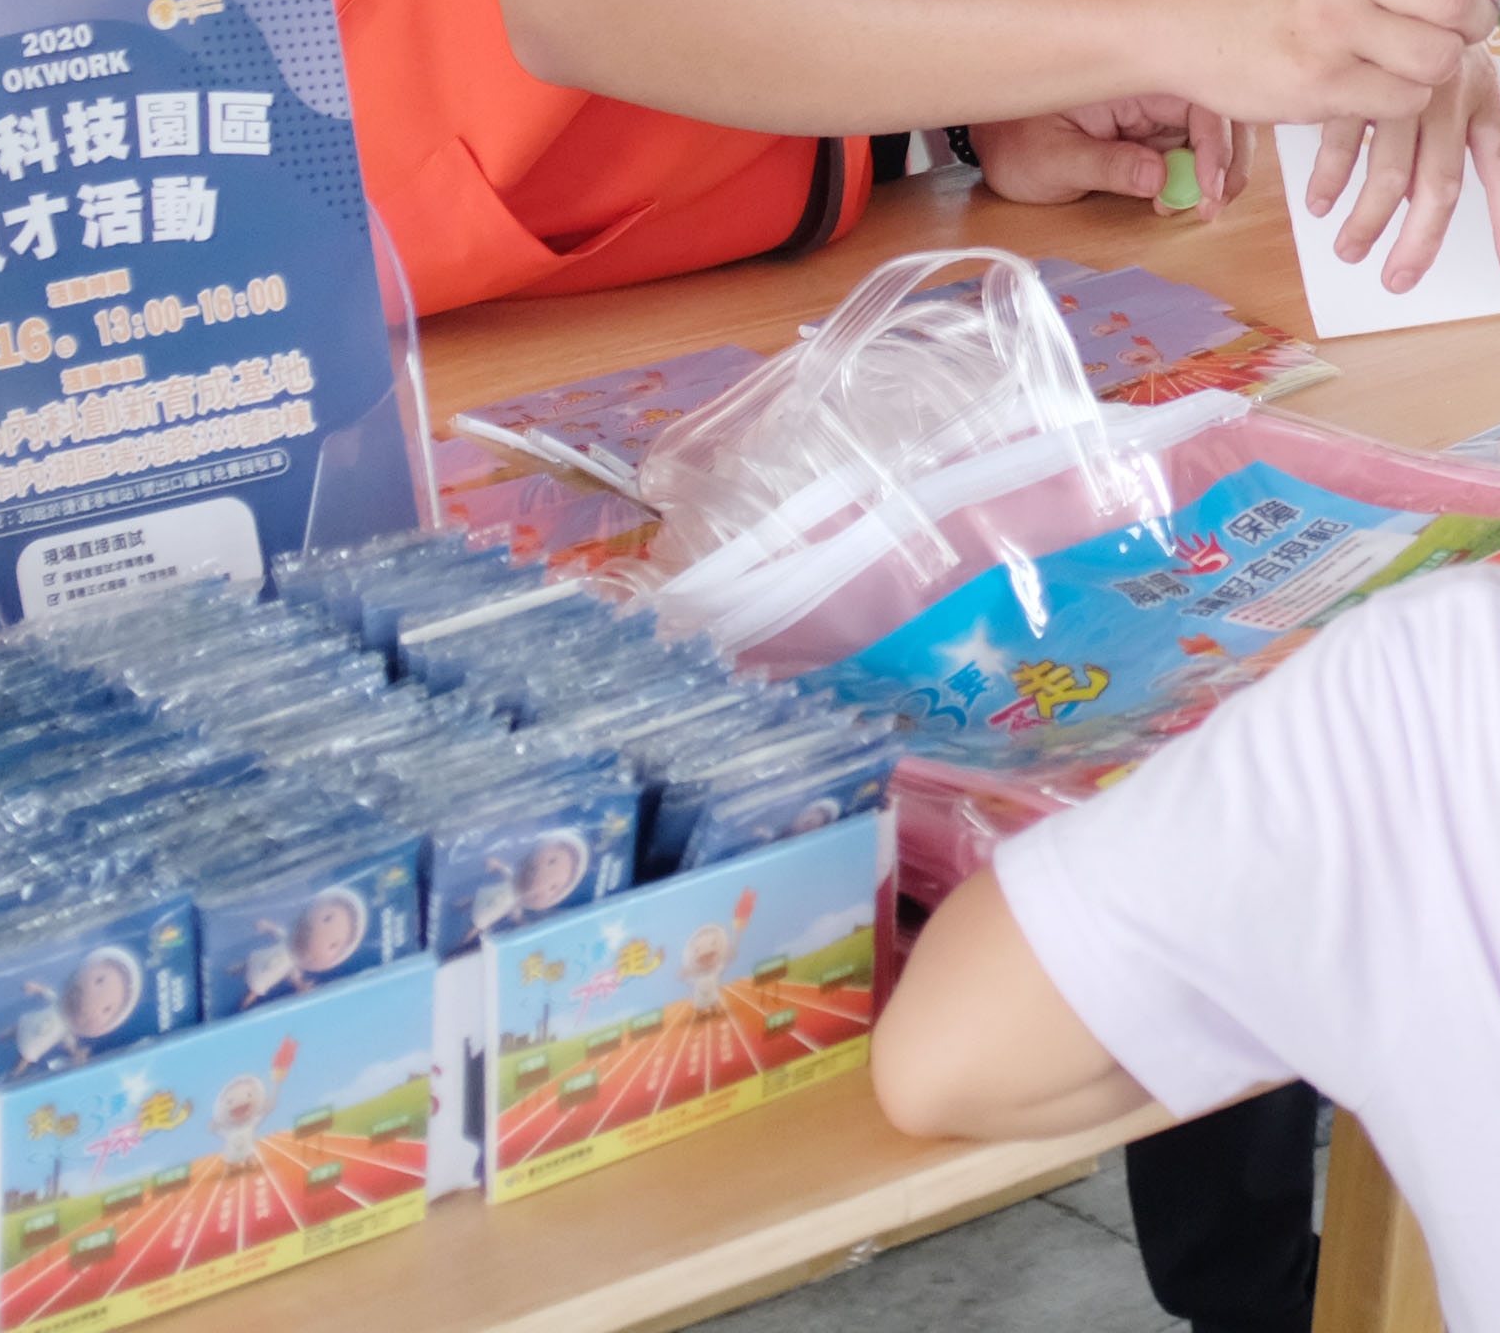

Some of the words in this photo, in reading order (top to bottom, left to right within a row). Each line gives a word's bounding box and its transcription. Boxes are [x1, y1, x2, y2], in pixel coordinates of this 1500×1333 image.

[21, 23, 94, 58] 2020
[1, 48, 133, 94] OKWORK
[93, 273, 287, 346] 13:00-16:00
